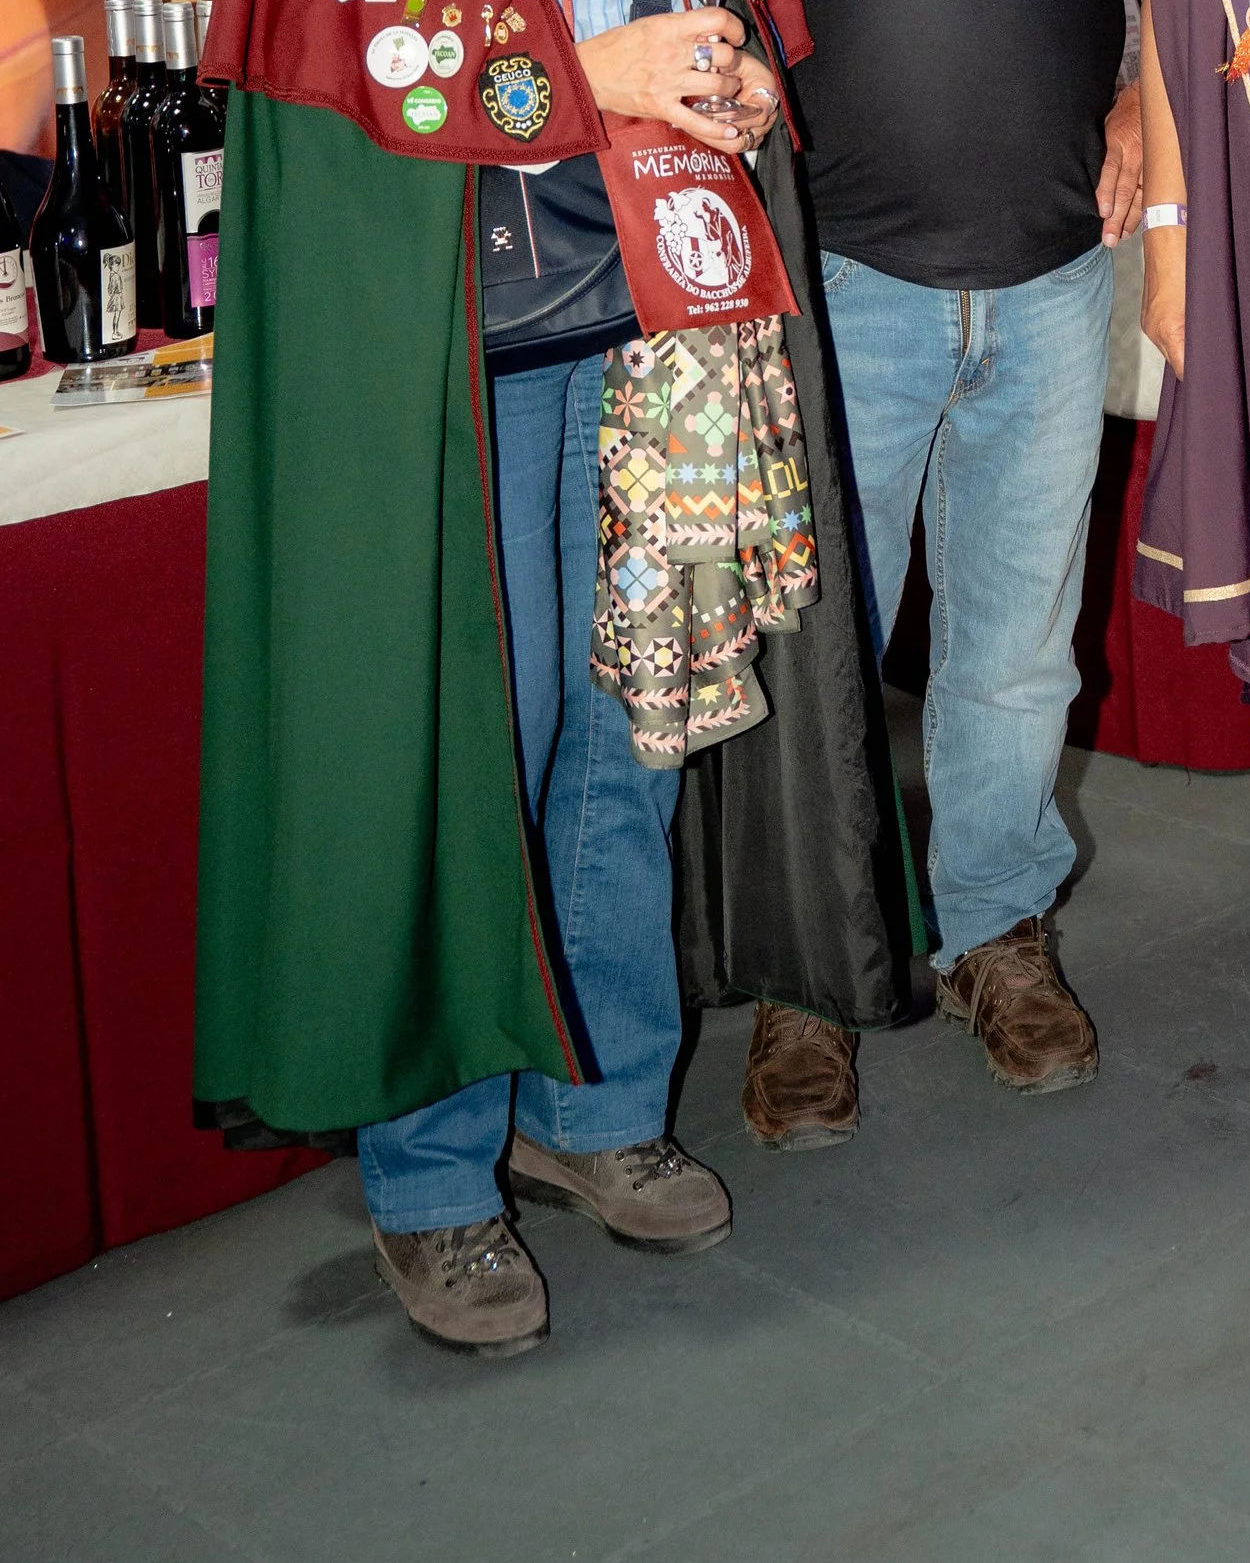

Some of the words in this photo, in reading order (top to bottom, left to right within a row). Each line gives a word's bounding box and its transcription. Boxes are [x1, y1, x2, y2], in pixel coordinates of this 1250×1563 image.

[494, 68, 532, 84] CEUCO
[632, 145, 685, 157] RESTAURANTE
[634, 149, 731, 180] MEMÓRIAS
[196, 170, 223, 188] TOR
[656, 235, 686, 288] CONFRARIA
[686, 284, 700, 296] DO
[700, 283, 738, 300] BACCHUS
[736, 276, 747, 288] DE
[687, 305, 704, 316] Tel:
[705, 302, 719, 313] 962
[720, 300, 734, 311] 228
[735, 298, 749, 309] 930
